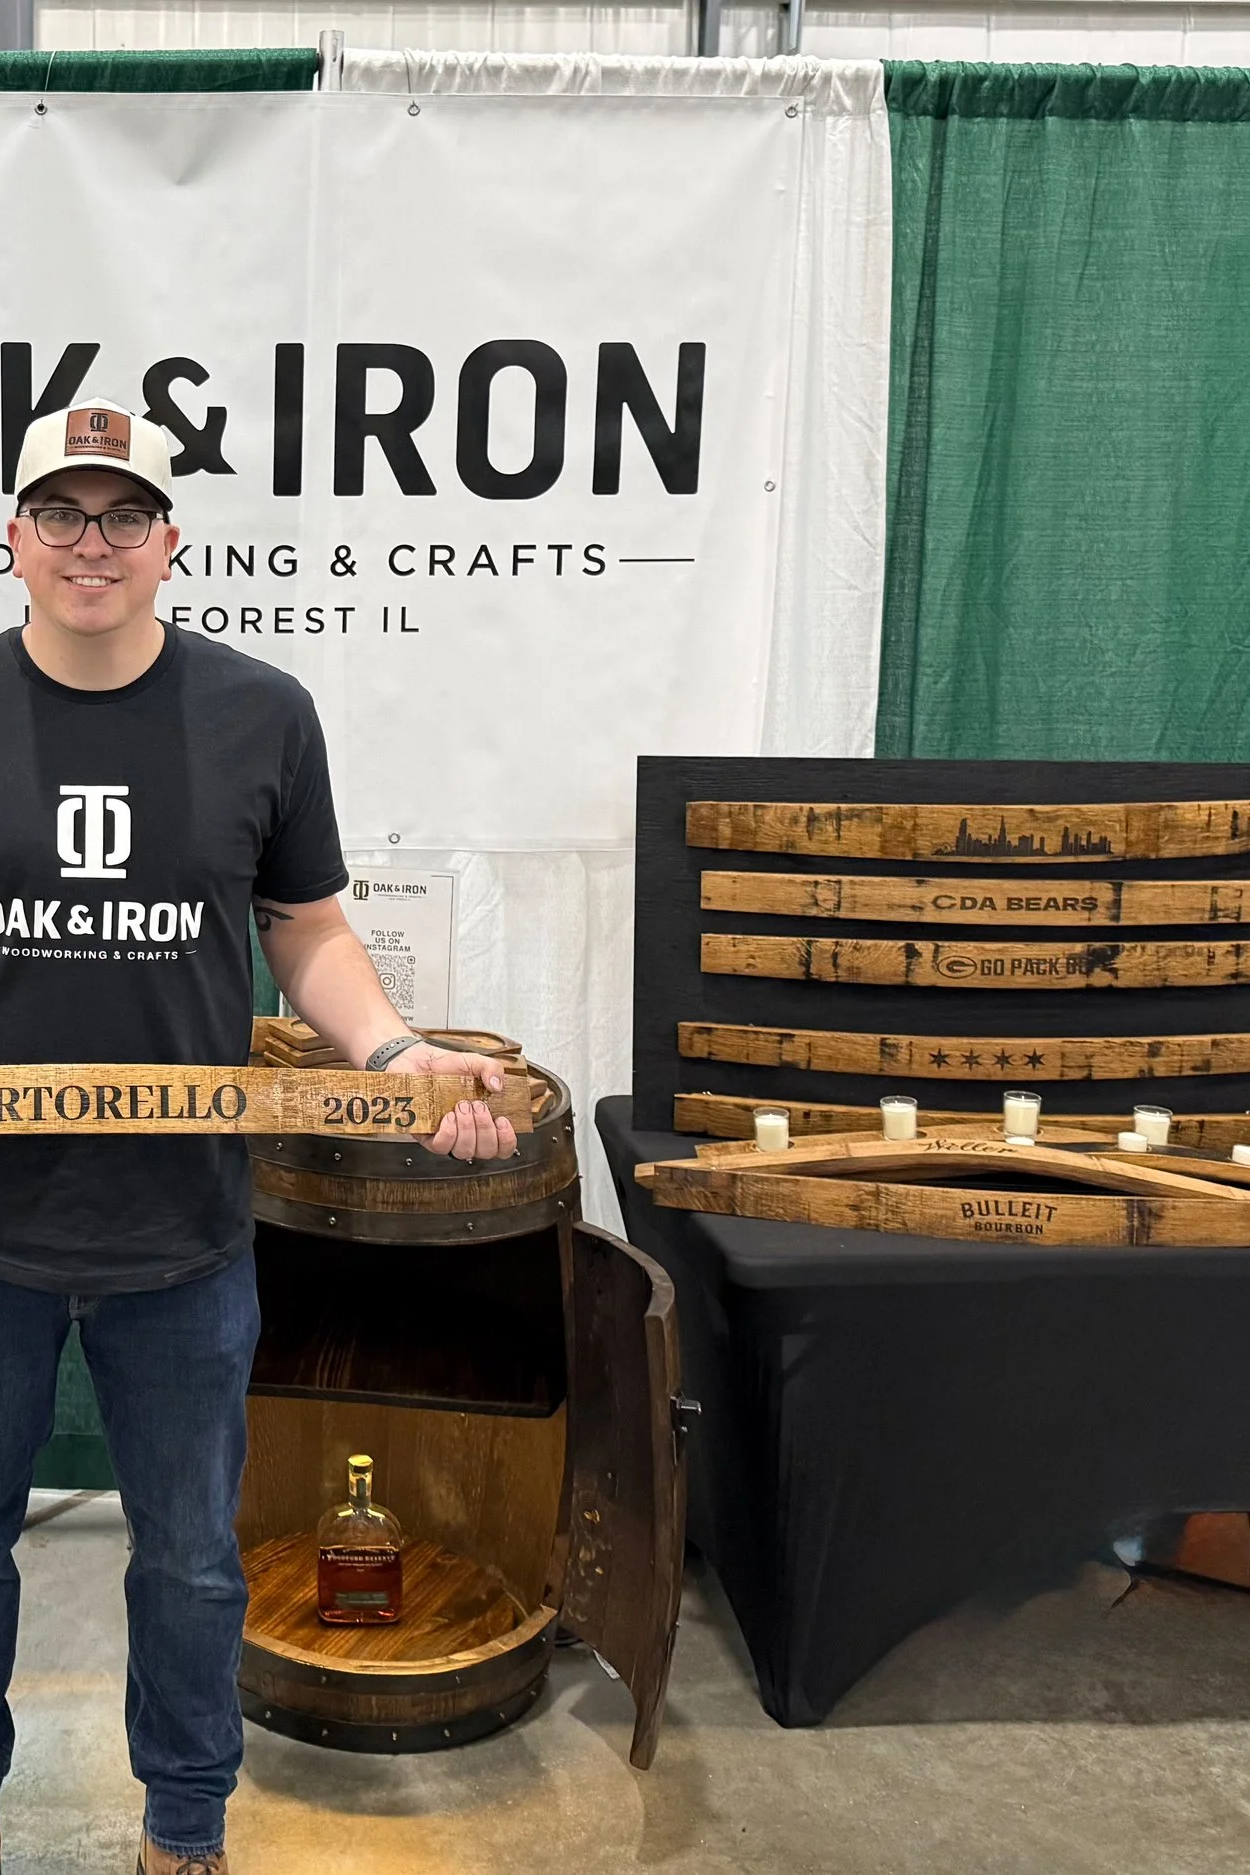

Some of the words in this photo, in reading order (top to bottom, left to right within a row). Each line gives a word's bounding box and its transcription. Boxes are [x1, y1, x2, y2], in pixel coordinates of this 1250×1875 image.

[142, 356, 237, 476] &
[272, 339, 706, 500] IRON
[68, 435, 90, 445] OAK
[92, 436, 99, 444] &
[100, 436, 127, 449] IRON
[330, 544, 358, 577] &
[388, 543, 608, 577] CRAFTS
[171, 605, 356, 634] FOREST
[382, 605, 420, 633] IL
[373, 882, 393, 892] OAK
[402, 884, 427, 895] IRON
[960, 896, 997, 911] DA
[1006, 896, 1099, 911] BEARS
[67, 904, 95, 935] &
[102, 901, 204, 942] IRON
[371, 930, 405, 938] FOLLOW
[1, 946, 107, 960] WOODWORKING
[113, 950, 121, 960] &
[127, 950, 179, 960] CRAFTS
[981, 958, 1005, 976] GO
[1011, 957, 1060, 976] PACK
[323, 1096, 417, 1127] 2023
[961, 1200, 1058, 1223] BULLEIT
[974, 1221, 1044, 1235] BOURBON
